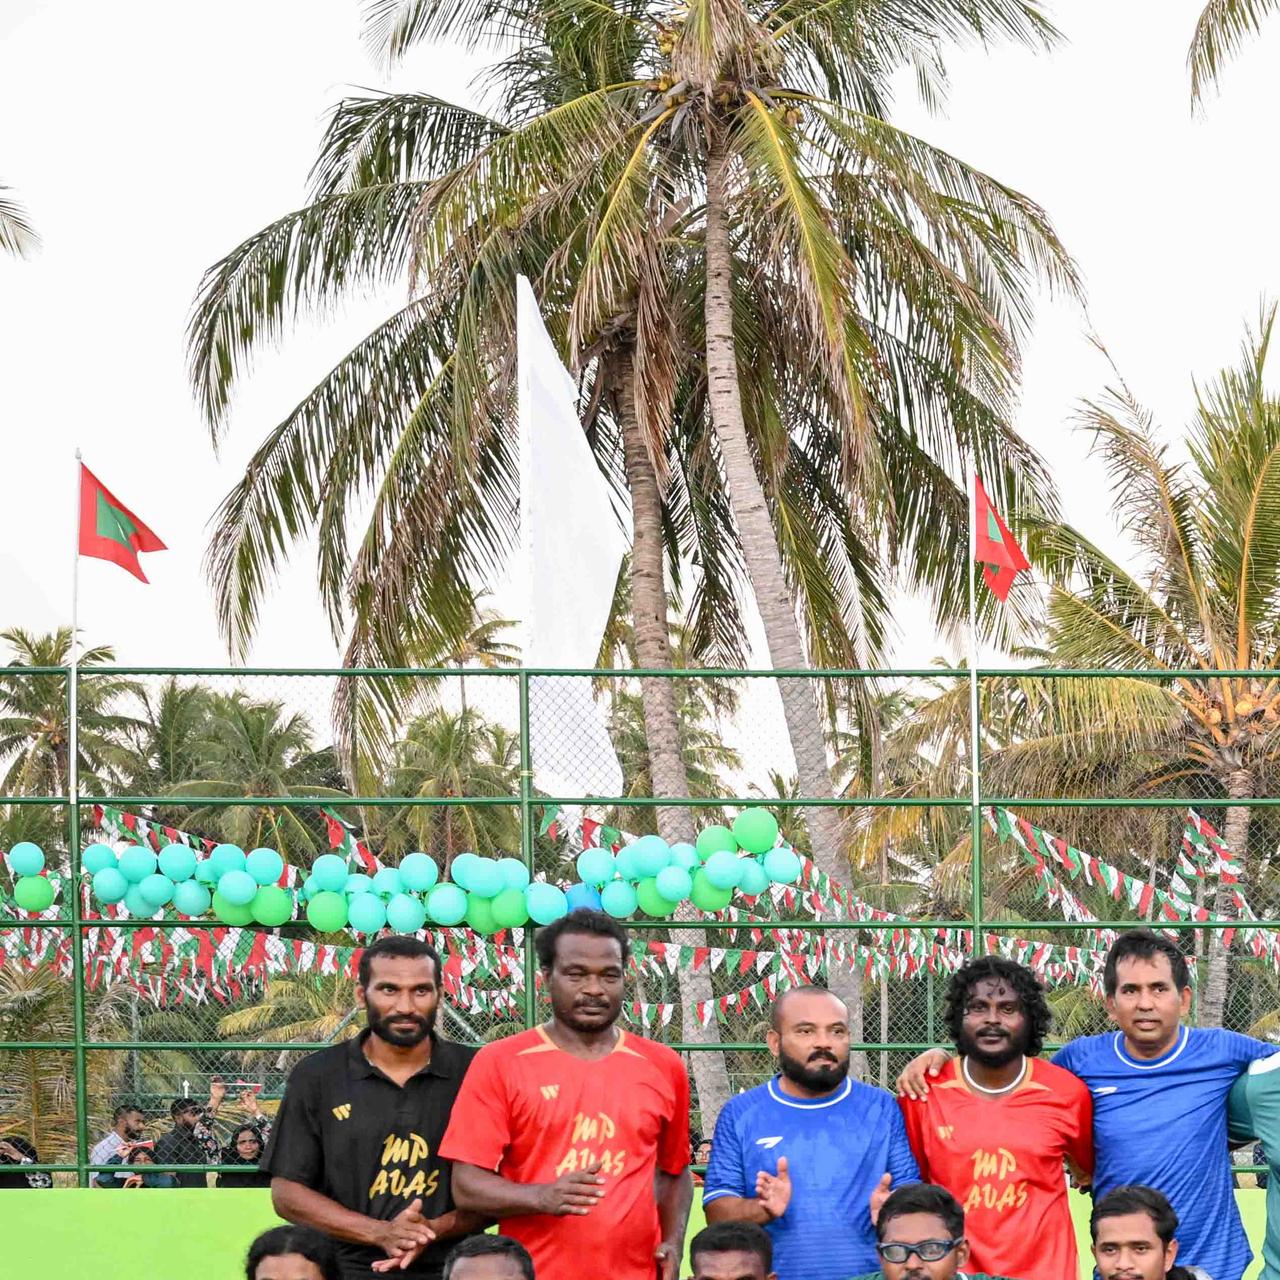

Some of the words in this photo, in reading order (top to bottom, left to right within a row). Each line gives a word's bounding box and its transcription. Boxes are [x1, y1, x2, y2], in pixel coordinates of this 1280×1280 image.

[571, 1111, 615, 1145] MP
[381, 1132, 429, 1168] MP
[970, 1147, 1016, 1181] MP
